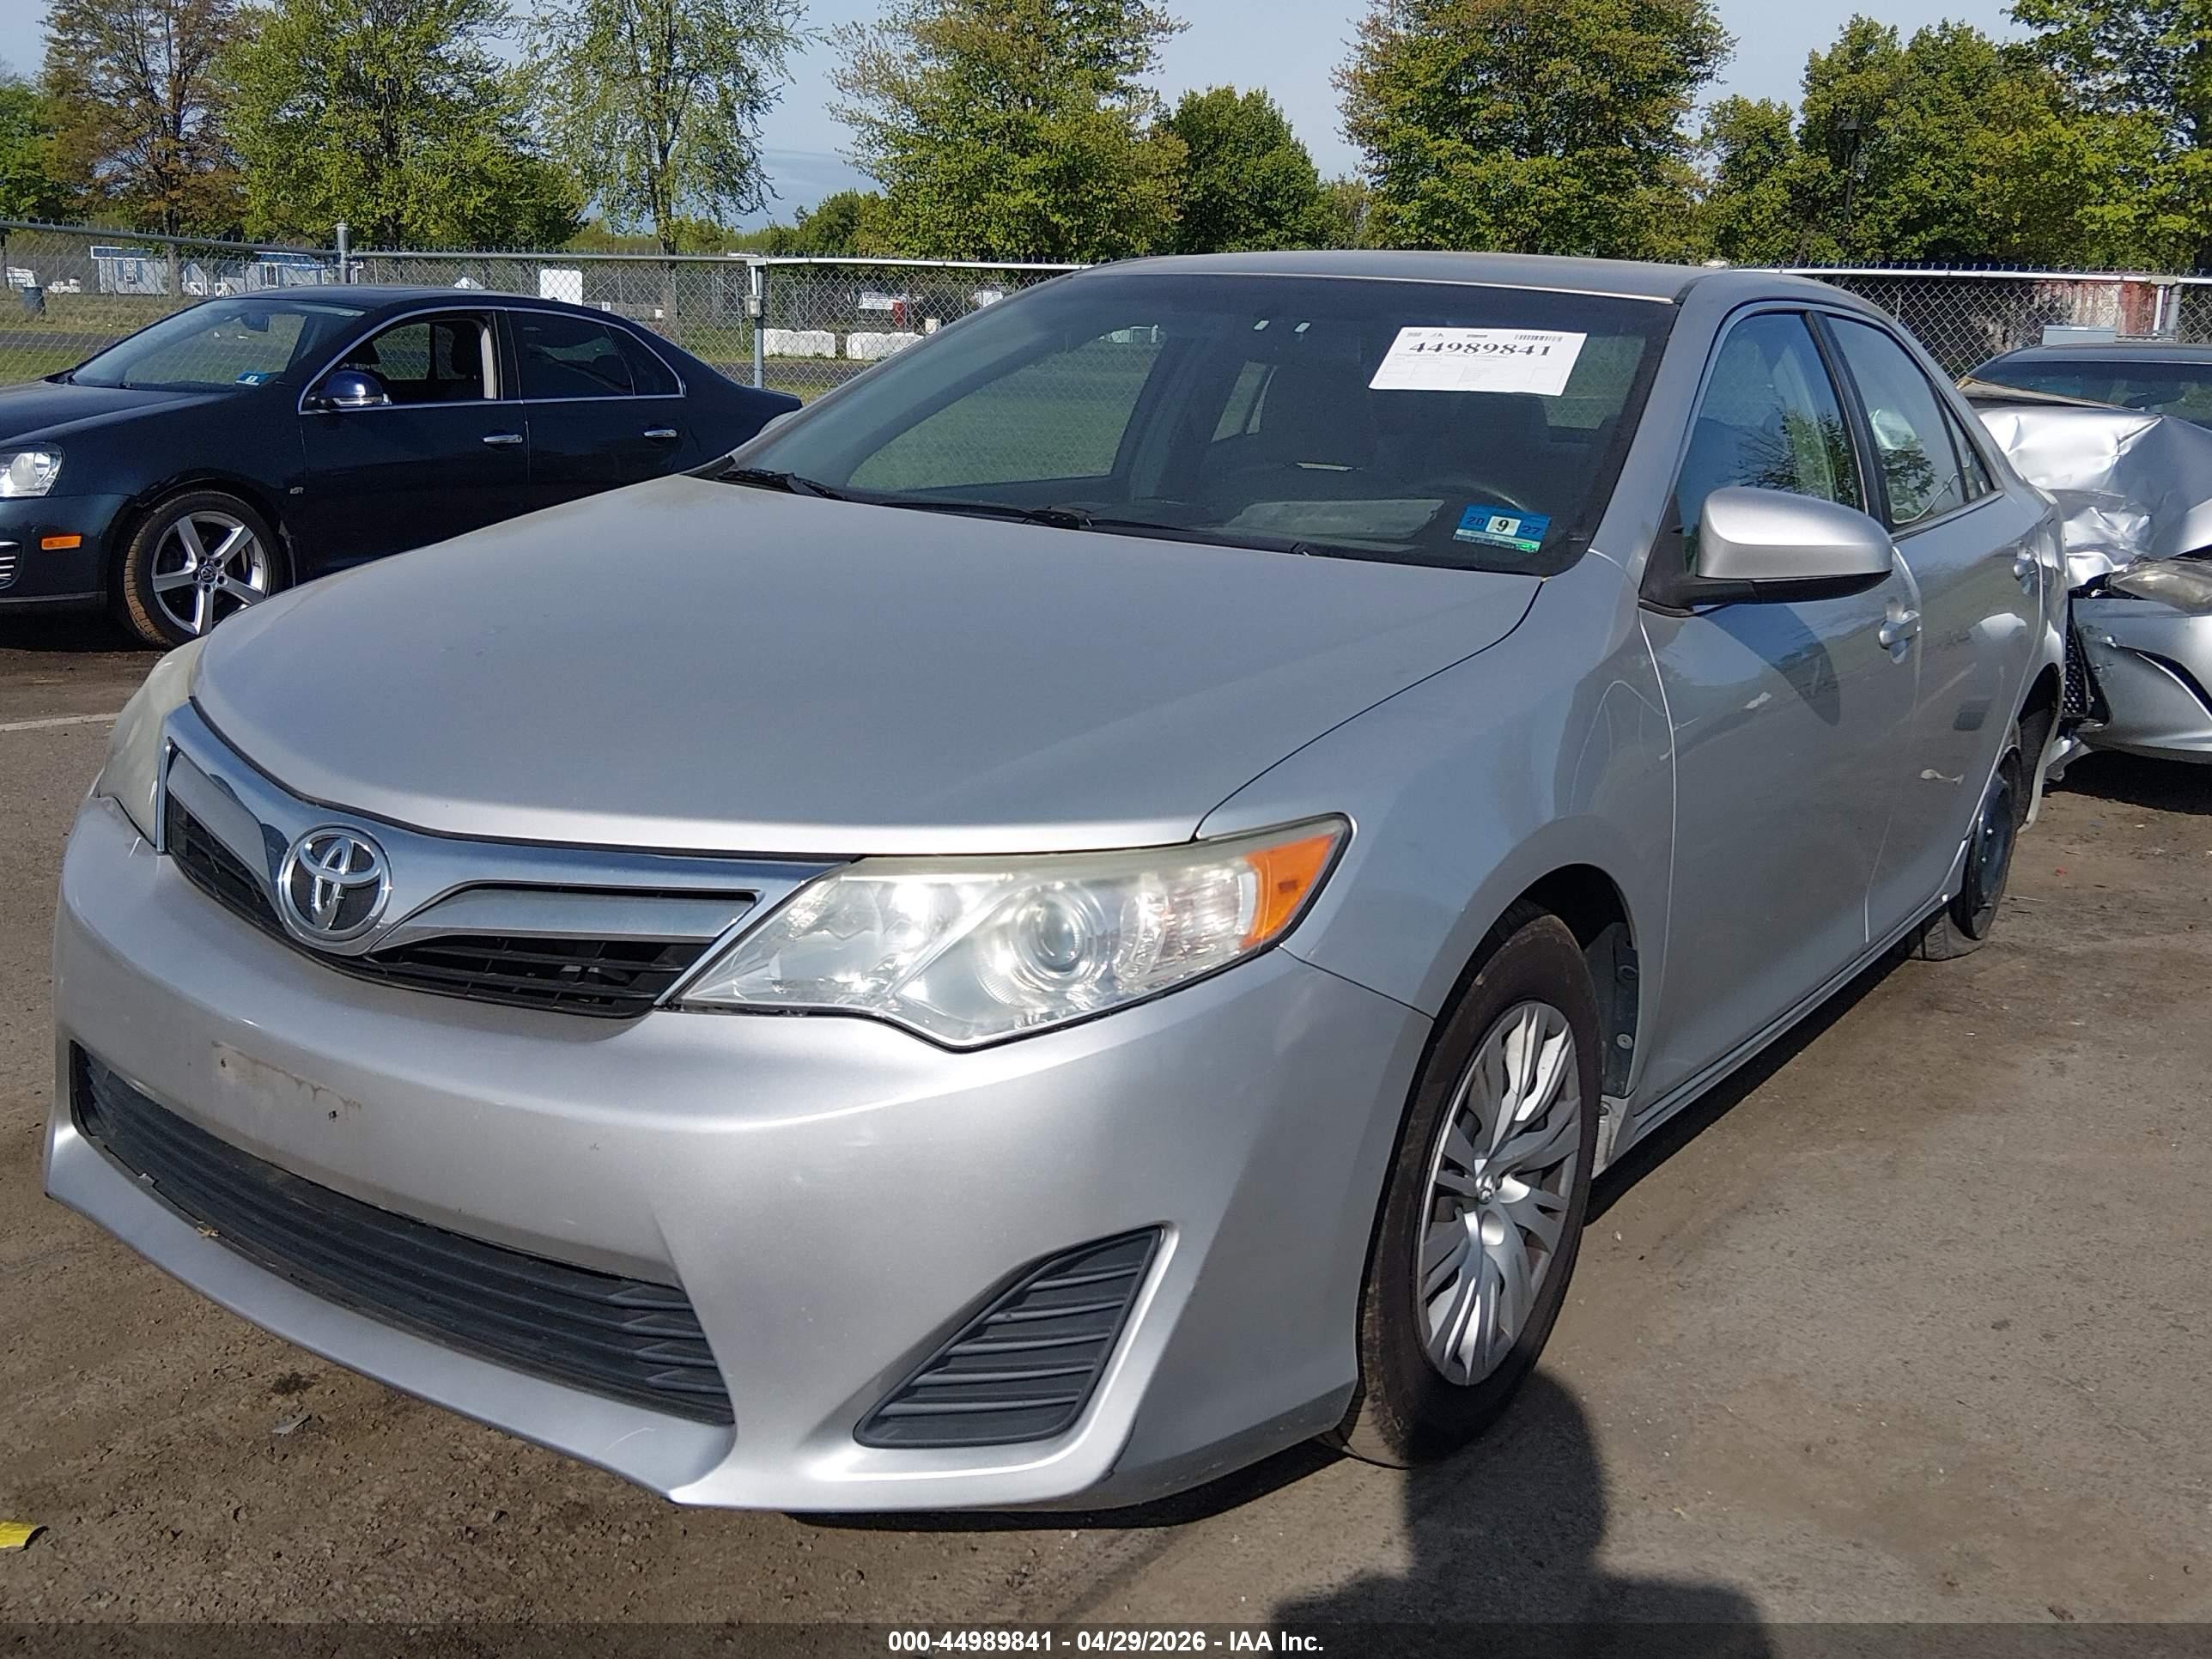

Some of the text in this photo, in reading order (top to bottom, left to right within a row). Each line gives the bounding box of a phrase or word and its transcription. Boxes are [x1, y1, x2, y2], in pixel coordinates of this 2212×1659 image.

[1410, 341, 1551, 356] 44989841
[1467, 516, 1542, 535] 20 9 27
